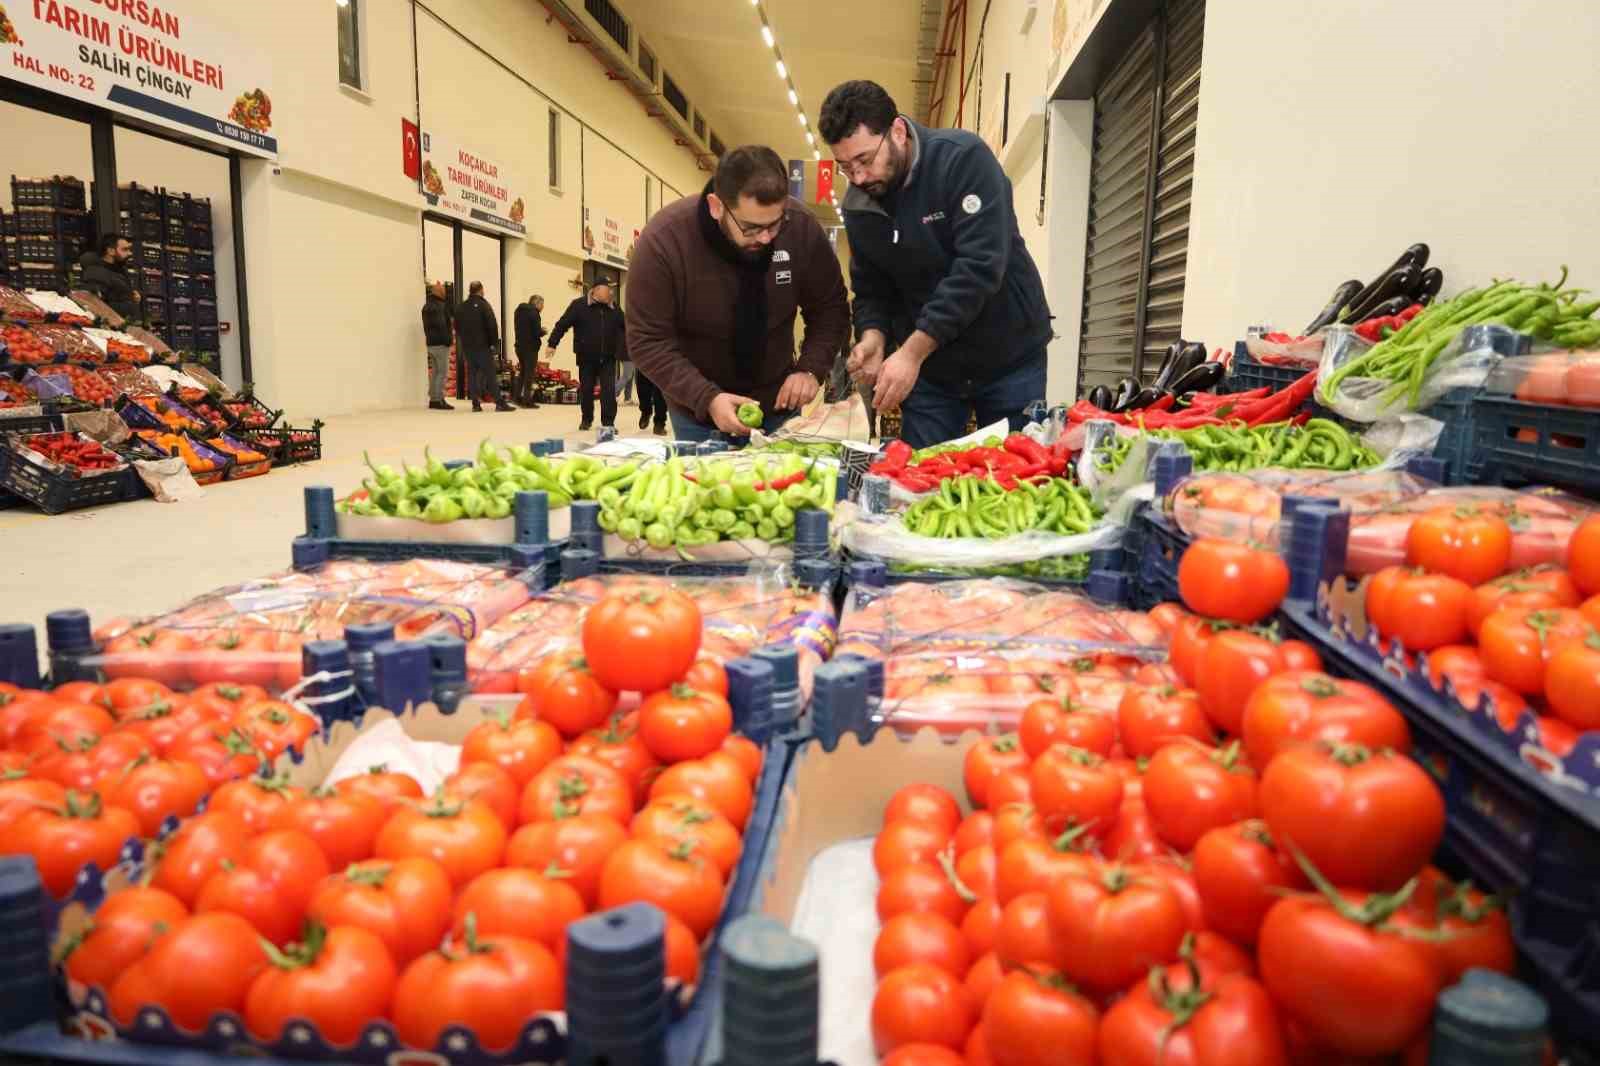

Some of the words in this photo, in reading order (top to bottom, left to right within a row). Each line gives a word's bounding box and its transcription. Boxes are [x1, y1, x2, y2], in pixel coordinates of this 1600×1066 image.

[89, 0, 179, 38] URSAN
[31, 0, 111, 46] TARIM
[118, 24, 223, 90] ÜRÜNLERİ
[13, 52, 44, 74] HAL
[49, 63, 74, 84] NO:
[78, 74, 95, 91] 22
[78, 44, 131, 78] SALİH
[136, 63, 192, 100] ÇİNGAY
[458, 149, 498, 178] KOÇAKLAR
[447, 166, 472, 187] TARIM
[473, 175, 508, 202] ÜRÜNLERİ
